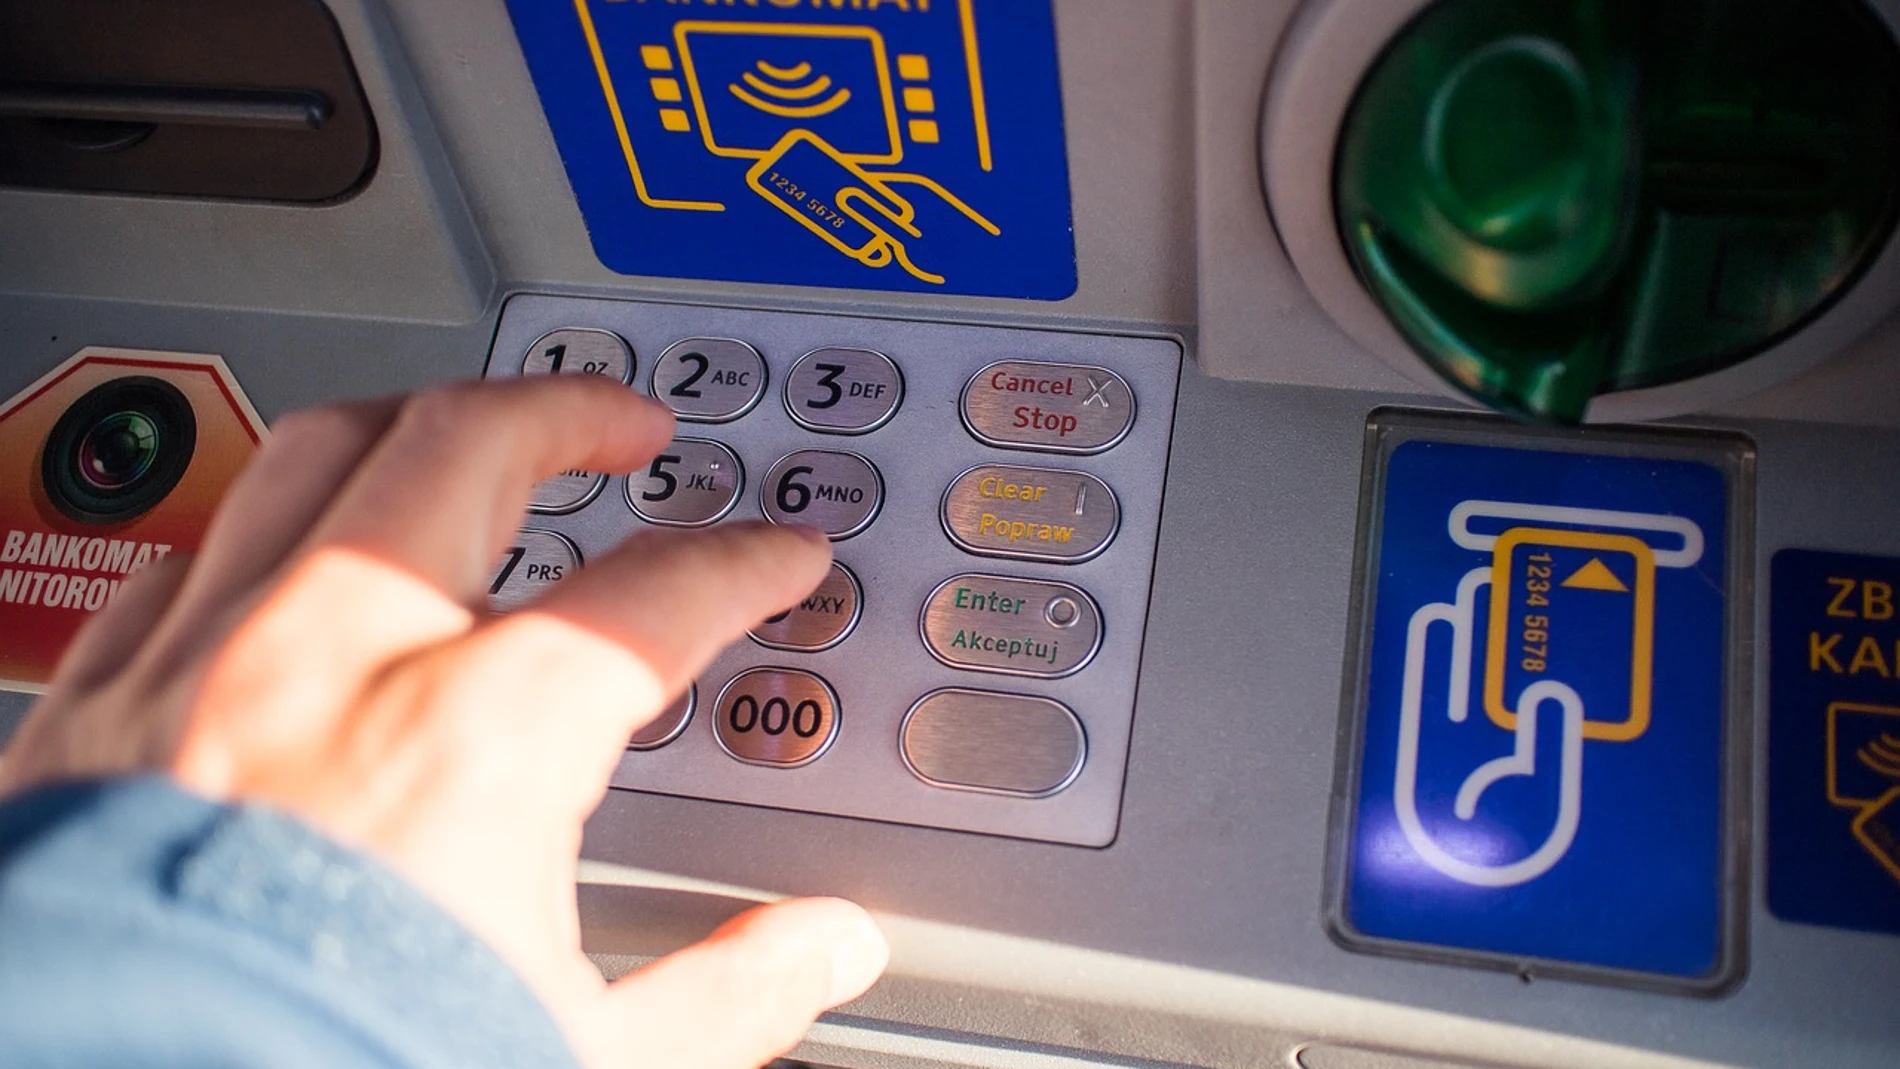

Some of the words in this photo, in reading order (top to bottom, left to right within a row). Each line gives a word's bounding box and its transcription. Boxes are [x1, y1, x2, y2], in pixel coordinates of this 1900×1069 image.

[768, 172, 807, 201] 1234
[807, 199, 845, 227] 5678
[669, 352, 709, 398] 2
[711, 370, 751, 387] ABC
[806, 363, 845, 409] 3
[849, 382, 887, 400] DEF
[991, 372, 1074, 396] Cancel
[1012, 406, 1077, 436] Stop
[642, 455, 681, 501] 5
[686, 475, 717, 492] JKL
[776, 466, 814, 514] 6
[814, 485, 863, 504] MNO
[978, 477, 1046, 502] Clear
[978, 513, 1075, 543] Popraw
[487, 547, 527, 595] 7
[527, 563, 564, 581] PRS
[1526, 551, 1552, 608] 1234
[954, 587, 1026, 615] Enter
[951, 629, 1059, 664] Akceptuj
[1521, 613, 1550, 672] 5678
[1808, 631, 1900, 678] KA
[729, 694, 823, 738] 000
